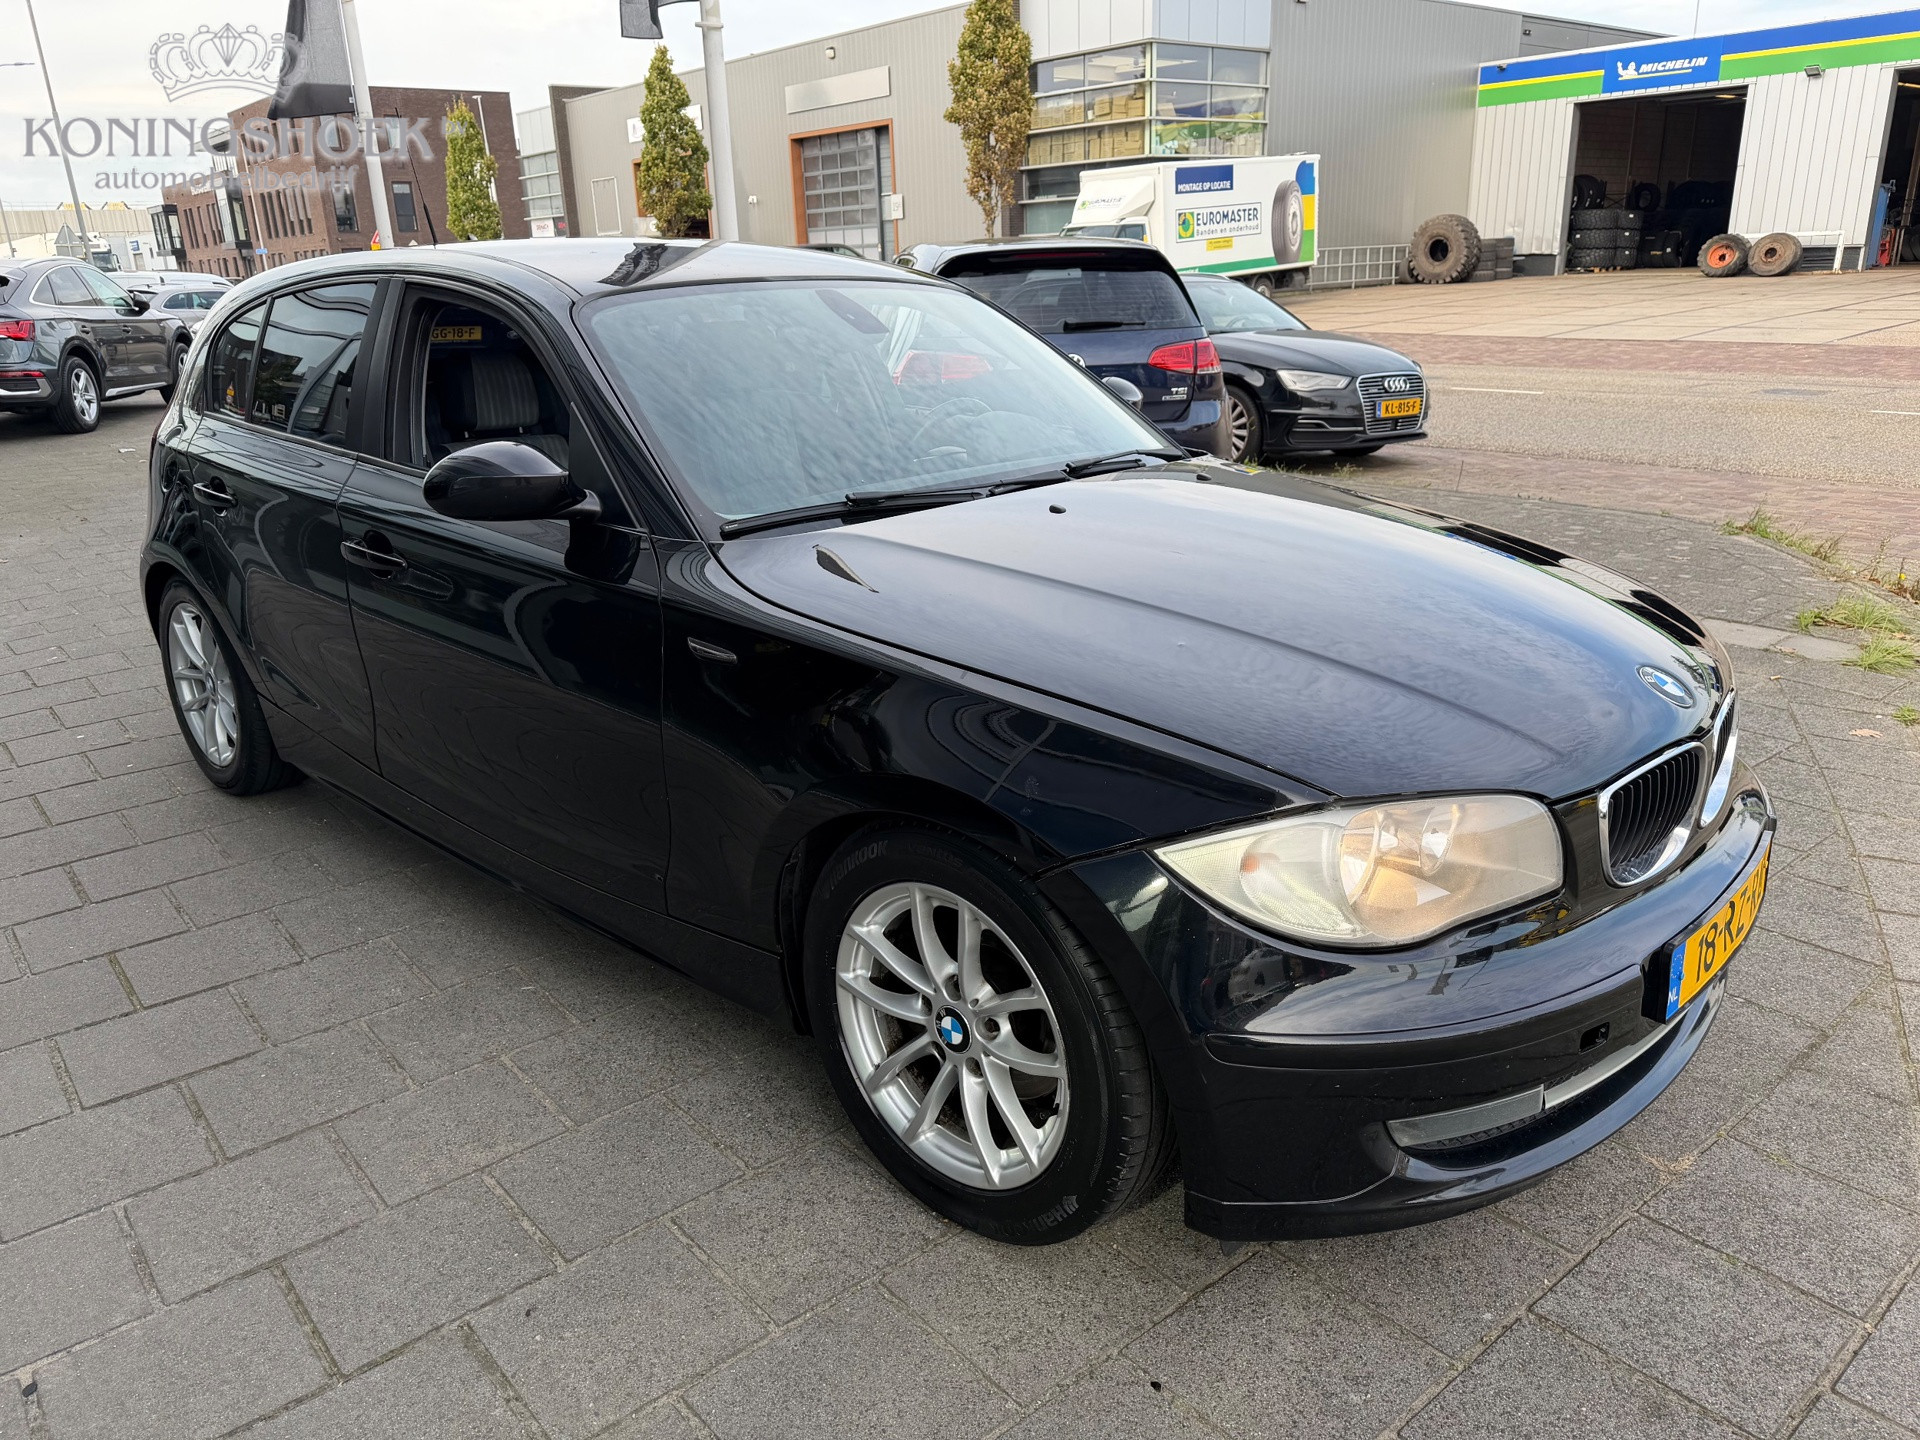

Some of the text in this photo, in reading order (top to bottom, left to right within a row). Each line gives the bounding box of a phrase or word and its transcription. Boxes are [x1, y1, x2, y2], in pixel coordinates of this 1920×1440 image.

[1639, 56, 1708, 73] MICHELIN
[1177, 180, 1231, 192] MONTAGE OP LOCATIE
[1196, 207, 1259, 226] EUROMASTER
[1196, 227, 1218, 236] Banden
[1229, 222, 1259, 232] onderhoud
[1170, 386, 1188, 395] TSI
[1385, 401, 1417, 415] KL-815-F
[1667, 986, 1679, 1005] NL
